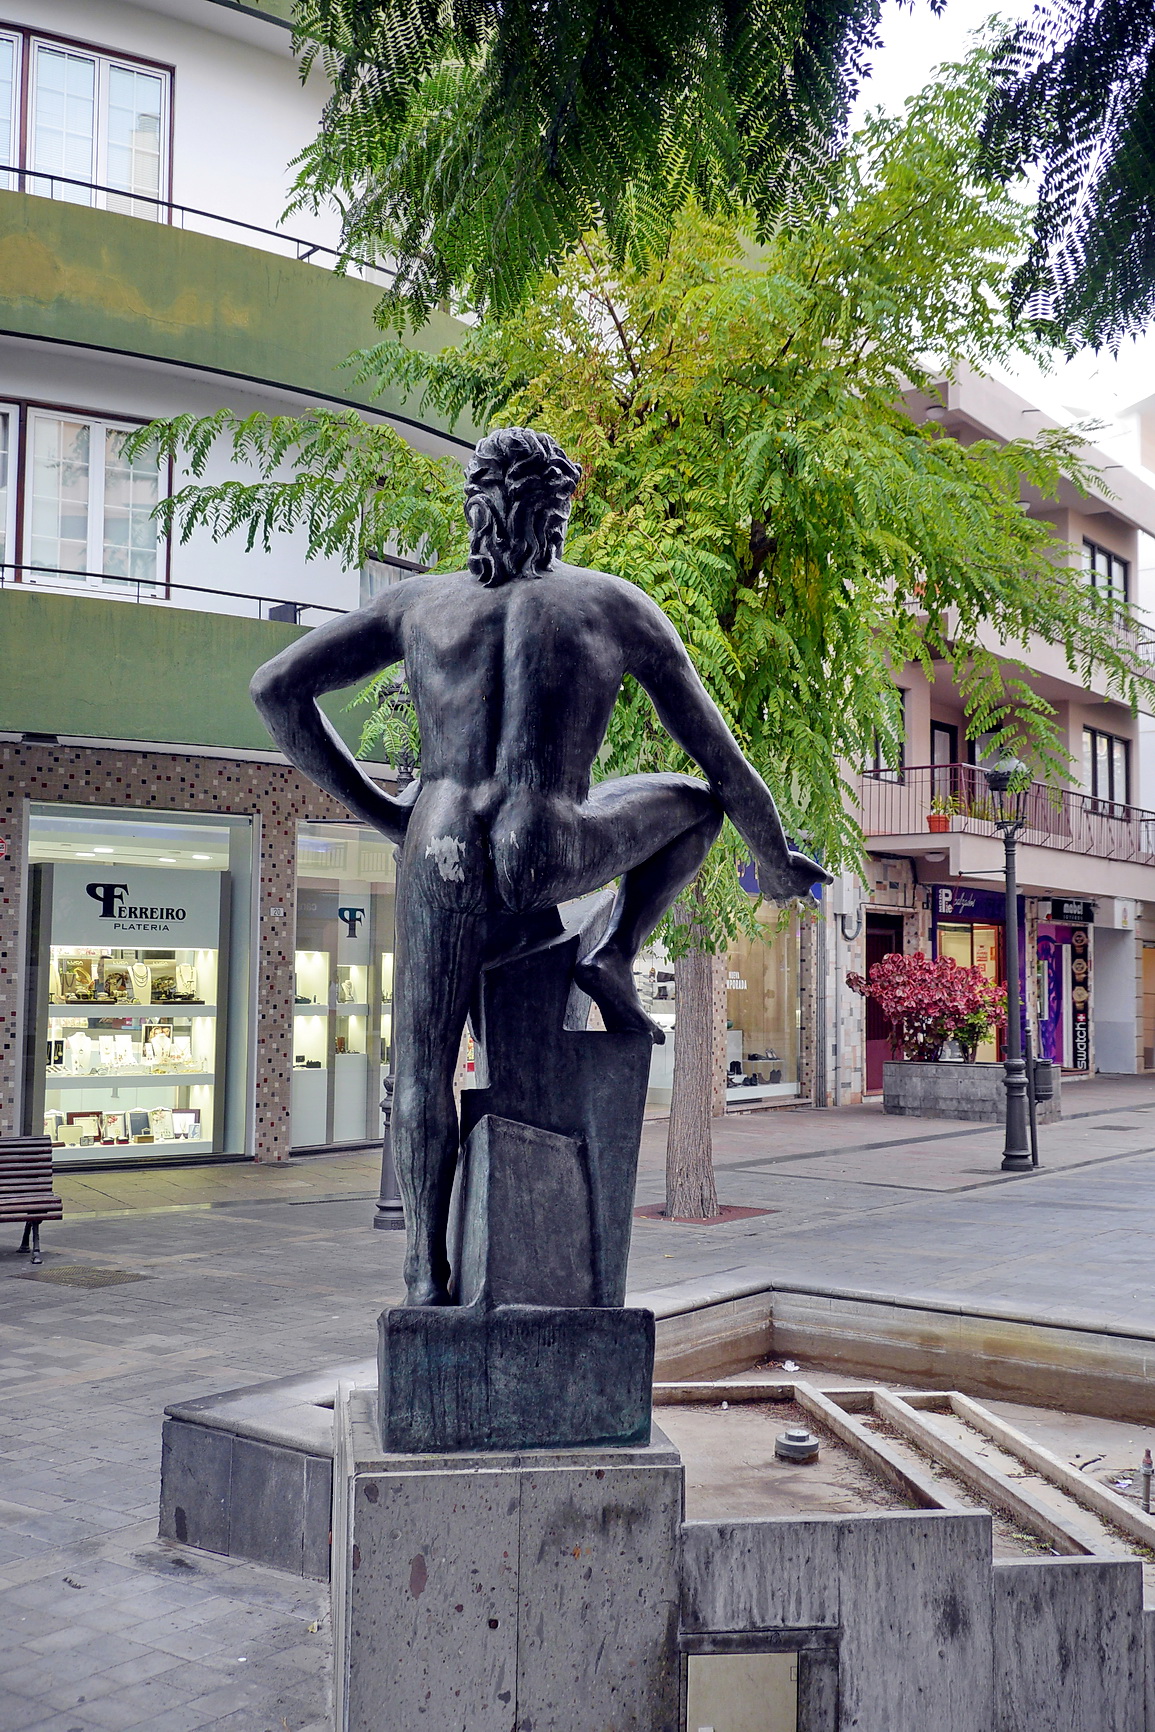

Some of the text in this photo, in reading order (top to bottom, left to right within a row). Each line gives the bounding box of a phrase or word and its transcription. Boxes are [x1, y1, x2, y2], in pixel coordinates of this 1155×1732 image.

[273, 908, 282, 916] 20
[113, 922, 170, 932] PLATERIA
[1074, 1021, 1087, 1070] swatch
